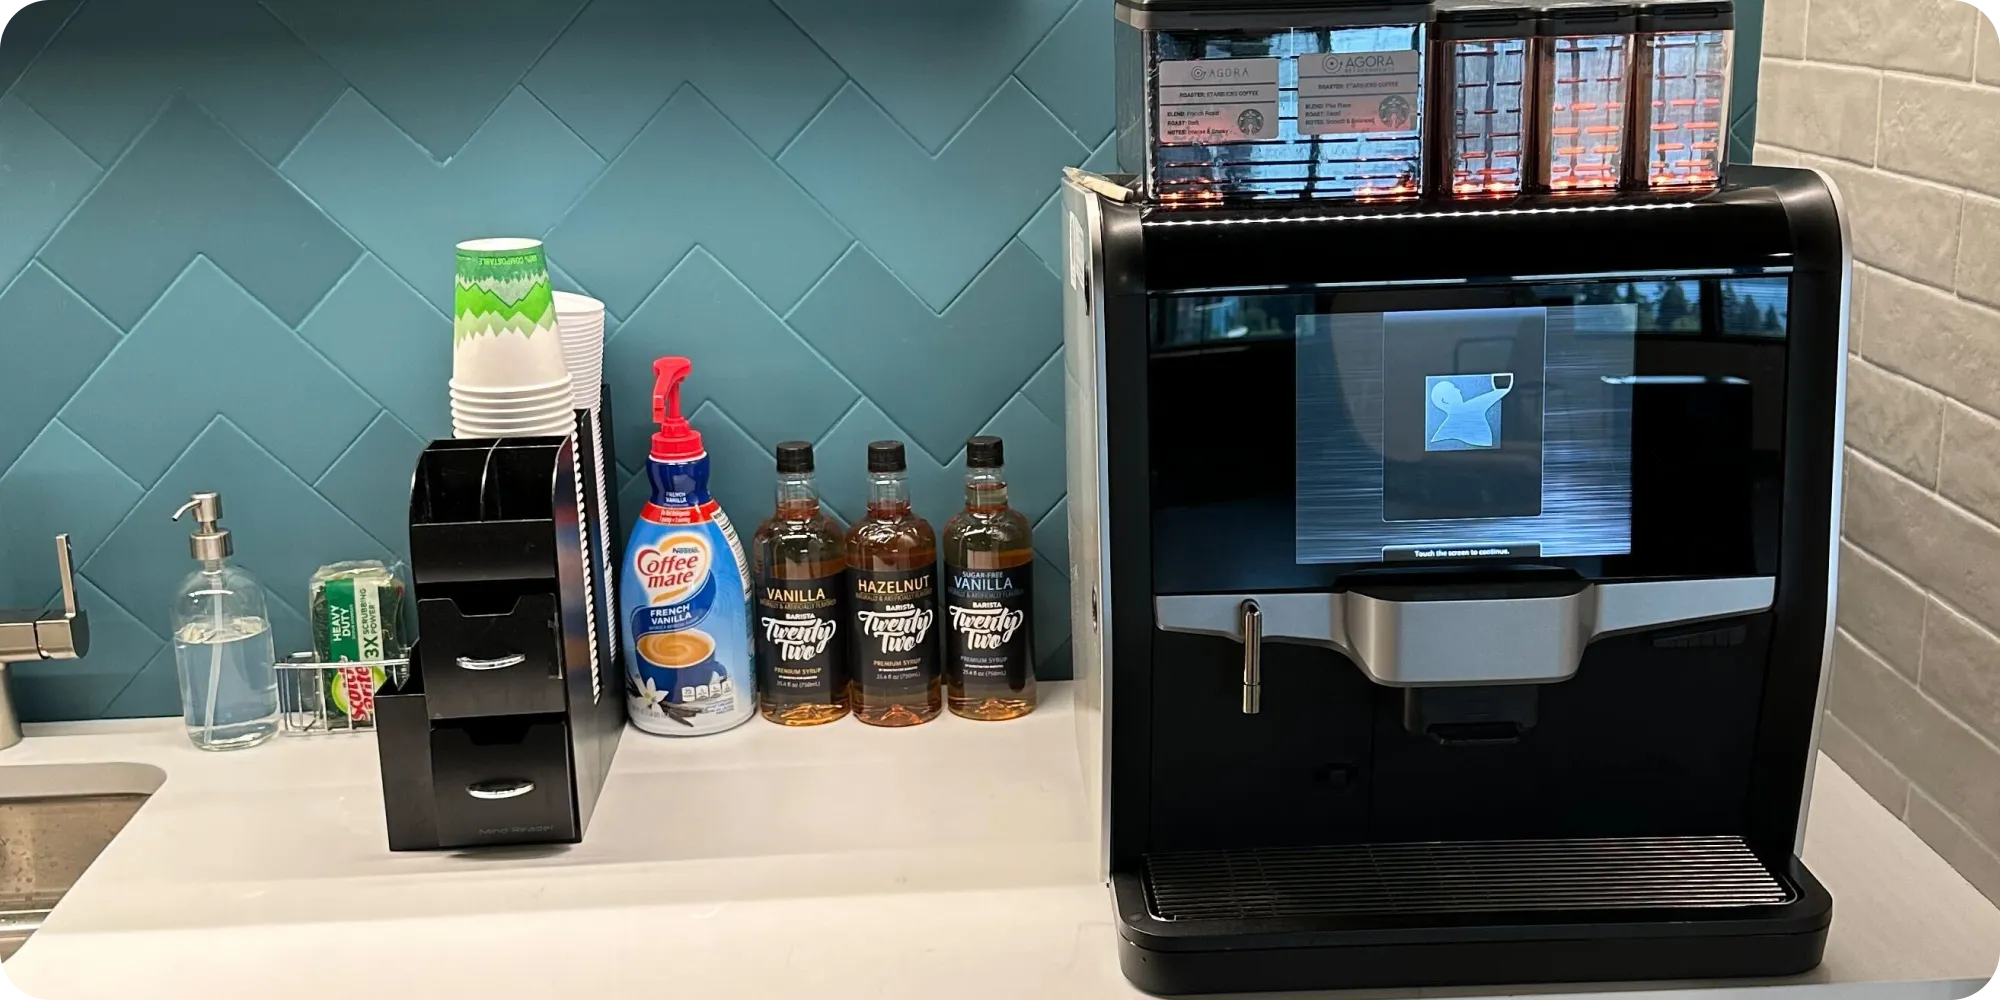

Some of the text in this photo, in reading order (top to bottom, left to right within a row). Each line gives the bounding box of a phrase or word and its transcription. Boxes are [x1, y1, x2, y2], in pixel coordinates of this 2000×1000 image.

[1346, 56, 1394, 68] AGORA
[1208, 68, 1250, 78] AGORA
[478, 256, 524, 266] COMPOSTABLE
[1414, 550, 1436, 558] Touch
[1478, 548, 1510, 556] continue.
[637, 548, 698, 576] Coffee
[648, 571, 694, 588] mate
[954, 575, 1013, 590] VANILLA
[962, 570, 1004, 578] SUGAR-FREE
[858, 574, 930, 594] HAZELNUT
[766, 587, 826, 602] VANILLA
[650, 604, 690, 617] FRENCH
[885, 604, 915, 612] BARISTA
[330, 604, 342, 642] HEAVY
[340, 608, 352, 637] DUTY
[360, 588, 379, 658] 3X SCRUBBING
[368, 604, 377, 634] POWER
[651, 612, 692, 625] VANILLA
[858, 608, 934, 644] Twenty
[949, 605, 1024, 643] Twenty
[761, 616, 836, 654] Twenty
[873, 630, 916, 654] Two
[960, 626, 1003, 650] Two
[774, 638, 817, 662] Two
[960, 656, 1008, 664] PREMIUM SYRUP
[774, 666, 822, 675] PREMIUM SYRUP
